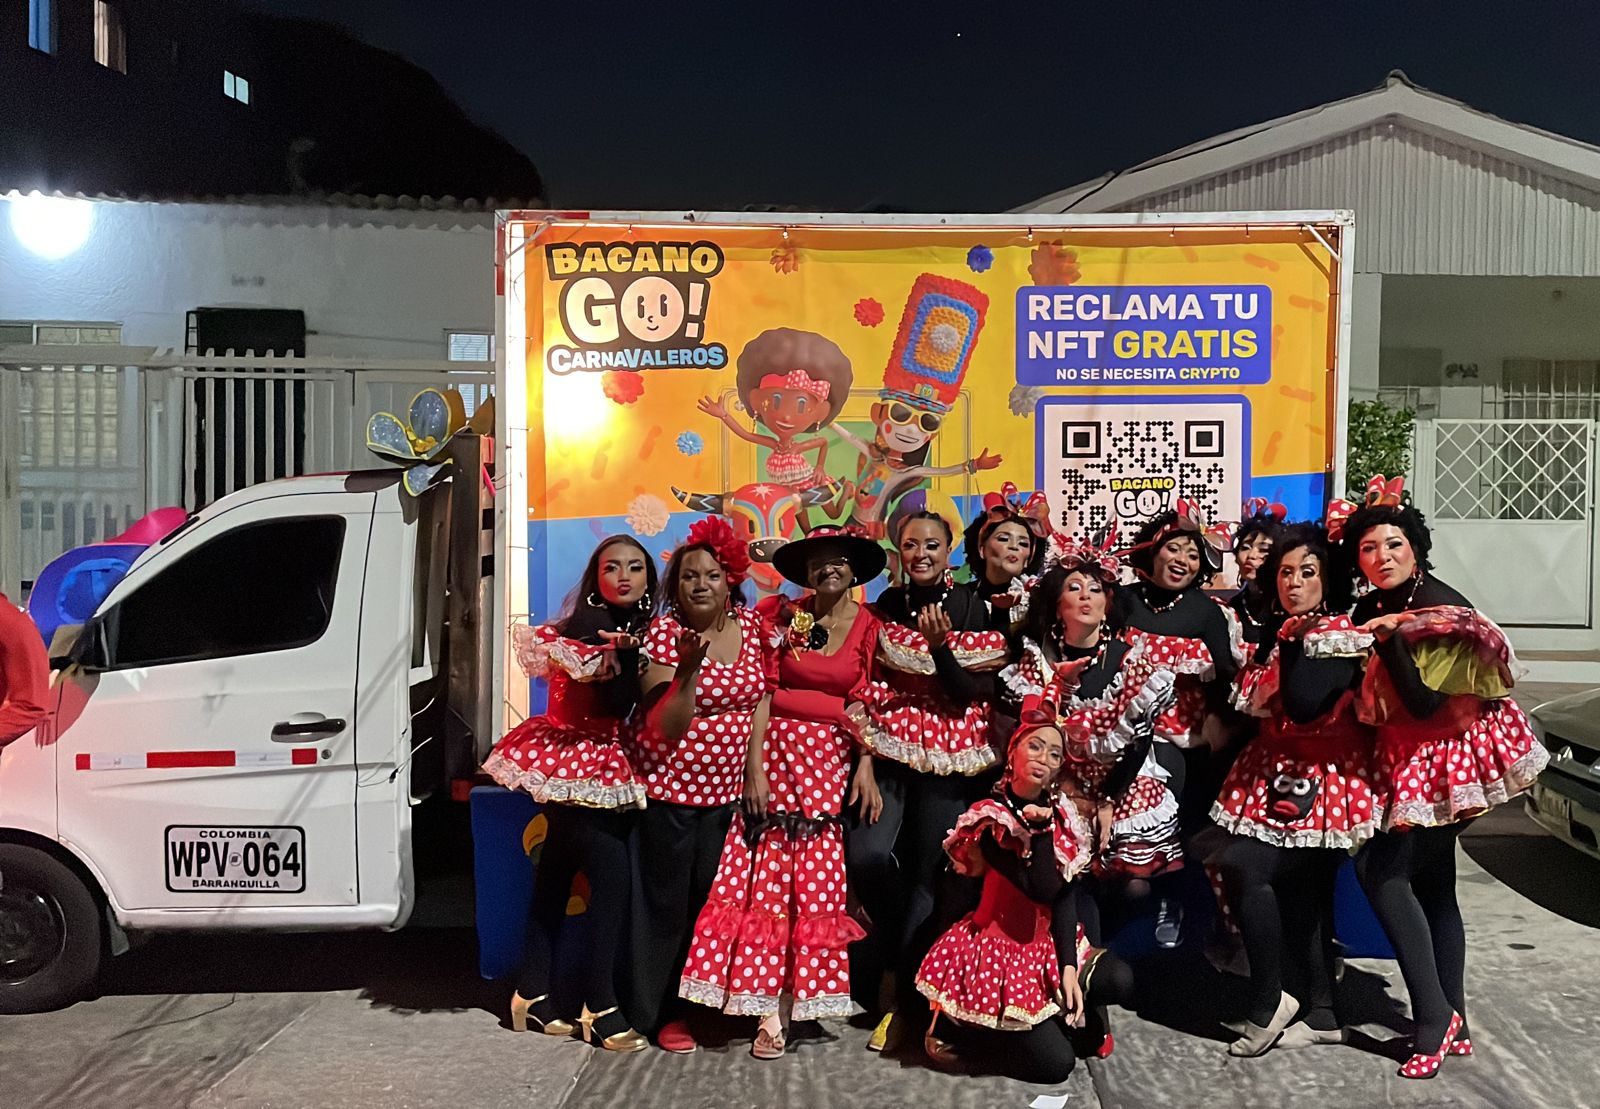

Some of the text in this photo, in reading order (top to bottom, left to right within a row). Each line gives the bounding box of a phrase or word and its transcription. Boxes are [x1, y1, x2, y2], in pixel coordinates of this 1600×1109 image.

[552, 246, 718, 275] BACANO
[566, 276, 704, 343] GO!
[1028, 293, 1258, 320] RECLAMA TU
[1028, 329, 1258, 359] NFT GRATIS
[1056, 367, 1240, 380] NO SE NECESITA CRYPTO
[1111, 477, 1175, 491] BACANO
[1115, 490, 1170, 517] GO!
[199, 830, 271, 838] COLOMBIA
[171, 841, 300, 877] WPV 064
[192, 879, 280, 888] BARRANQUILLA
